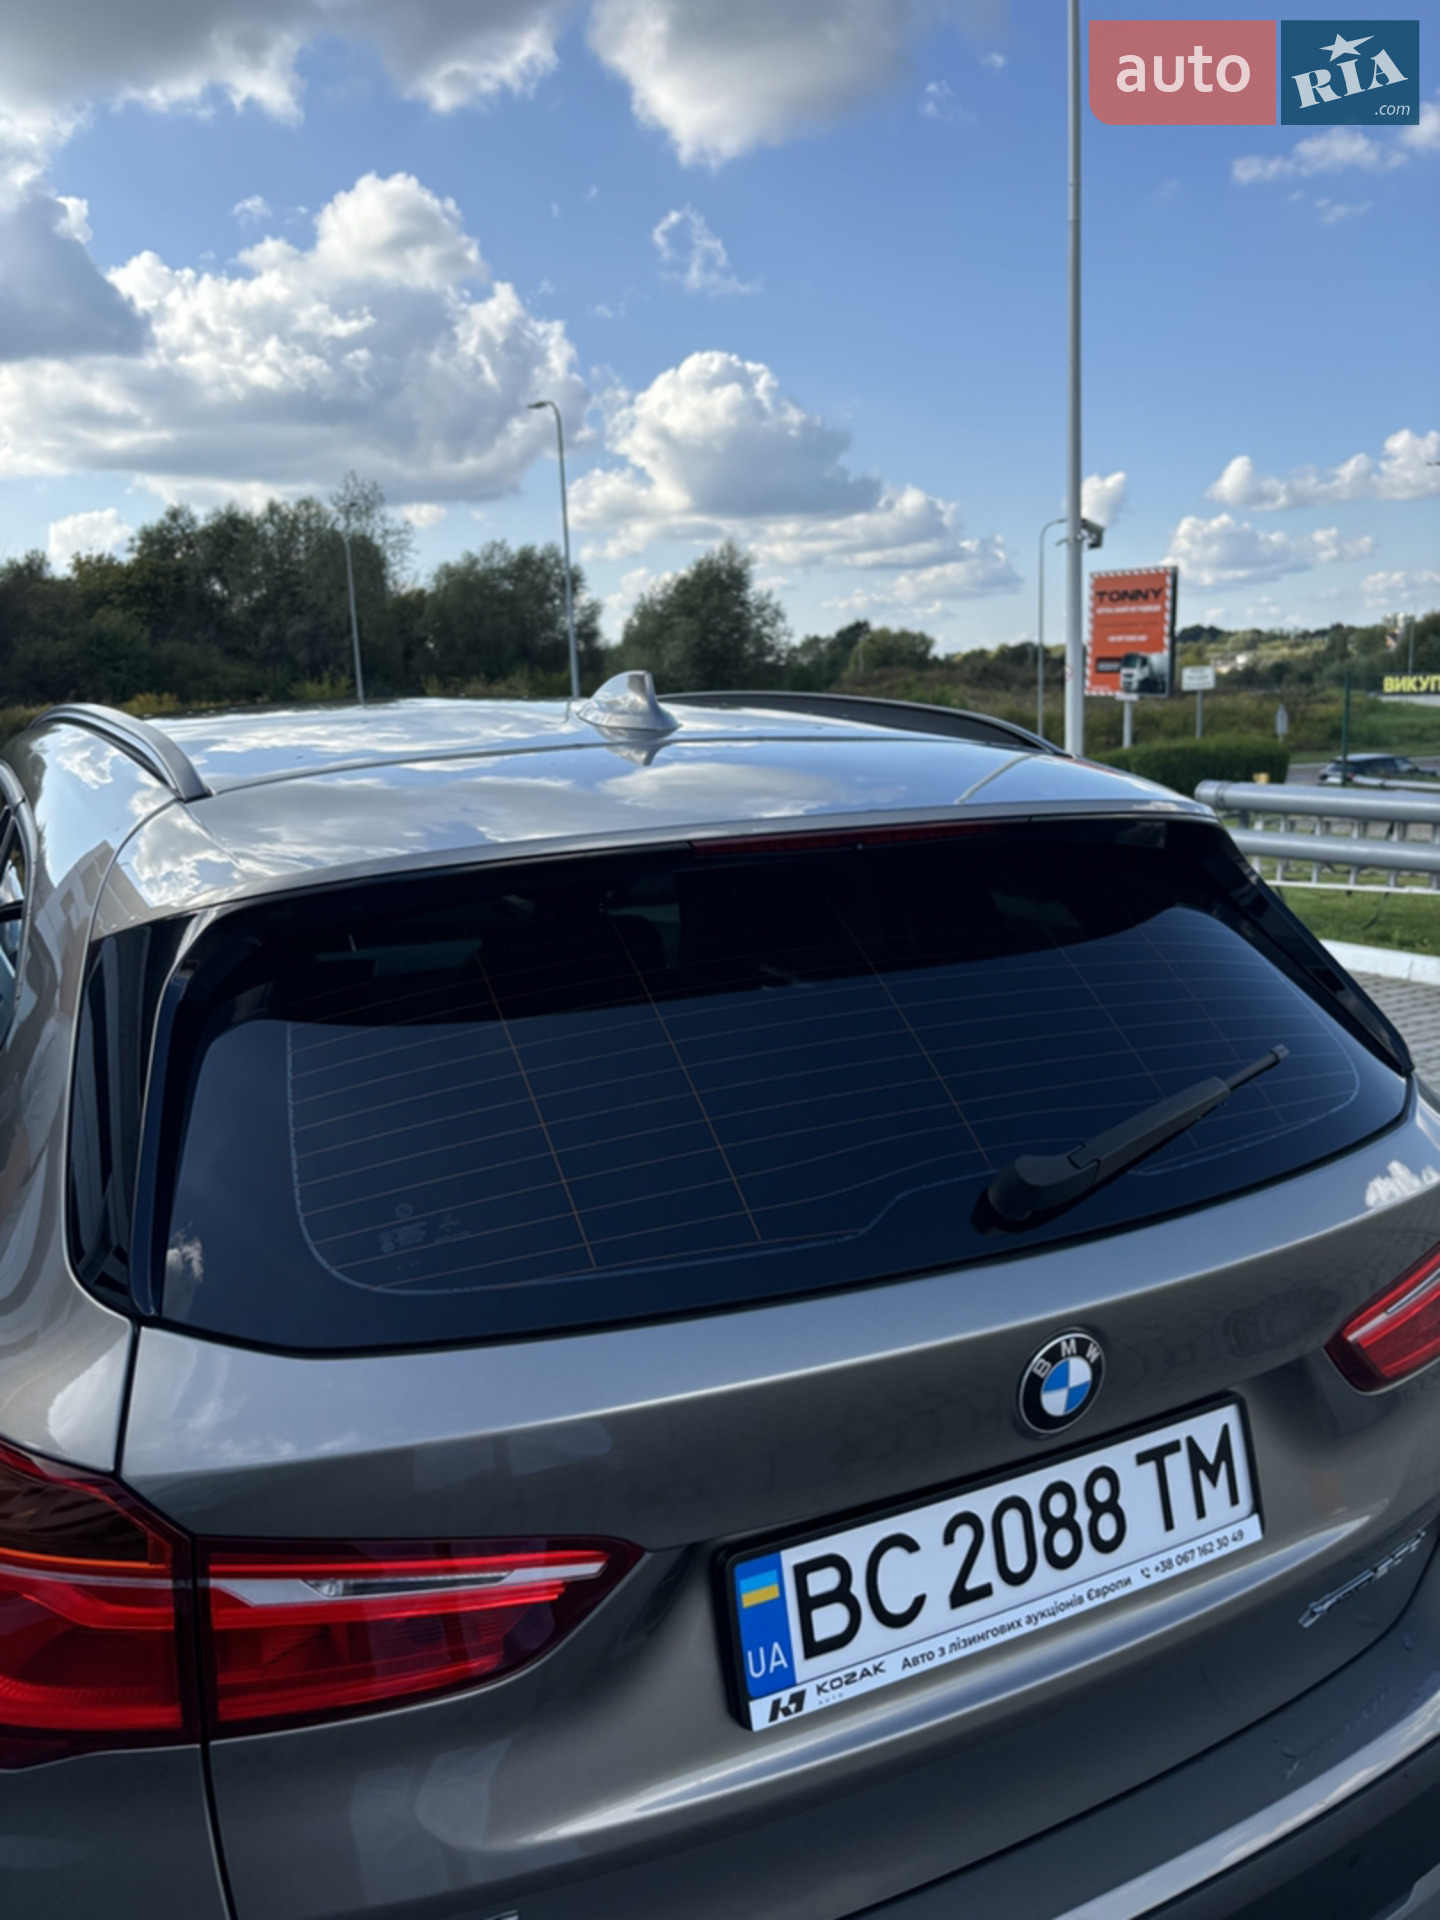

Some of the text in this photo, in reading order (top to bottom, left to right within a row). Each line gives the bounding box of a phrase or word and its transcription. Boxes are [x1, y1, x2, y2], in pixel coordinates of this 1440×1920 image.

[1095, 587, 1164, 603] TONNY
[1383, 675, 1440, 693] ВИКУП
[1032, 1338, 1101, 1379] BMW
[793, 1423, 1239, 1660] BC 2088 TM
[1154, 1528, 1244, 1574] +38 067 162 30 49
[901, 1576, 1132, 1671] Авто з лізингових аукціонів Європи
[747, 1641, 788, 1679] UA
[816, 1660, 886, 1696] KOZAK
